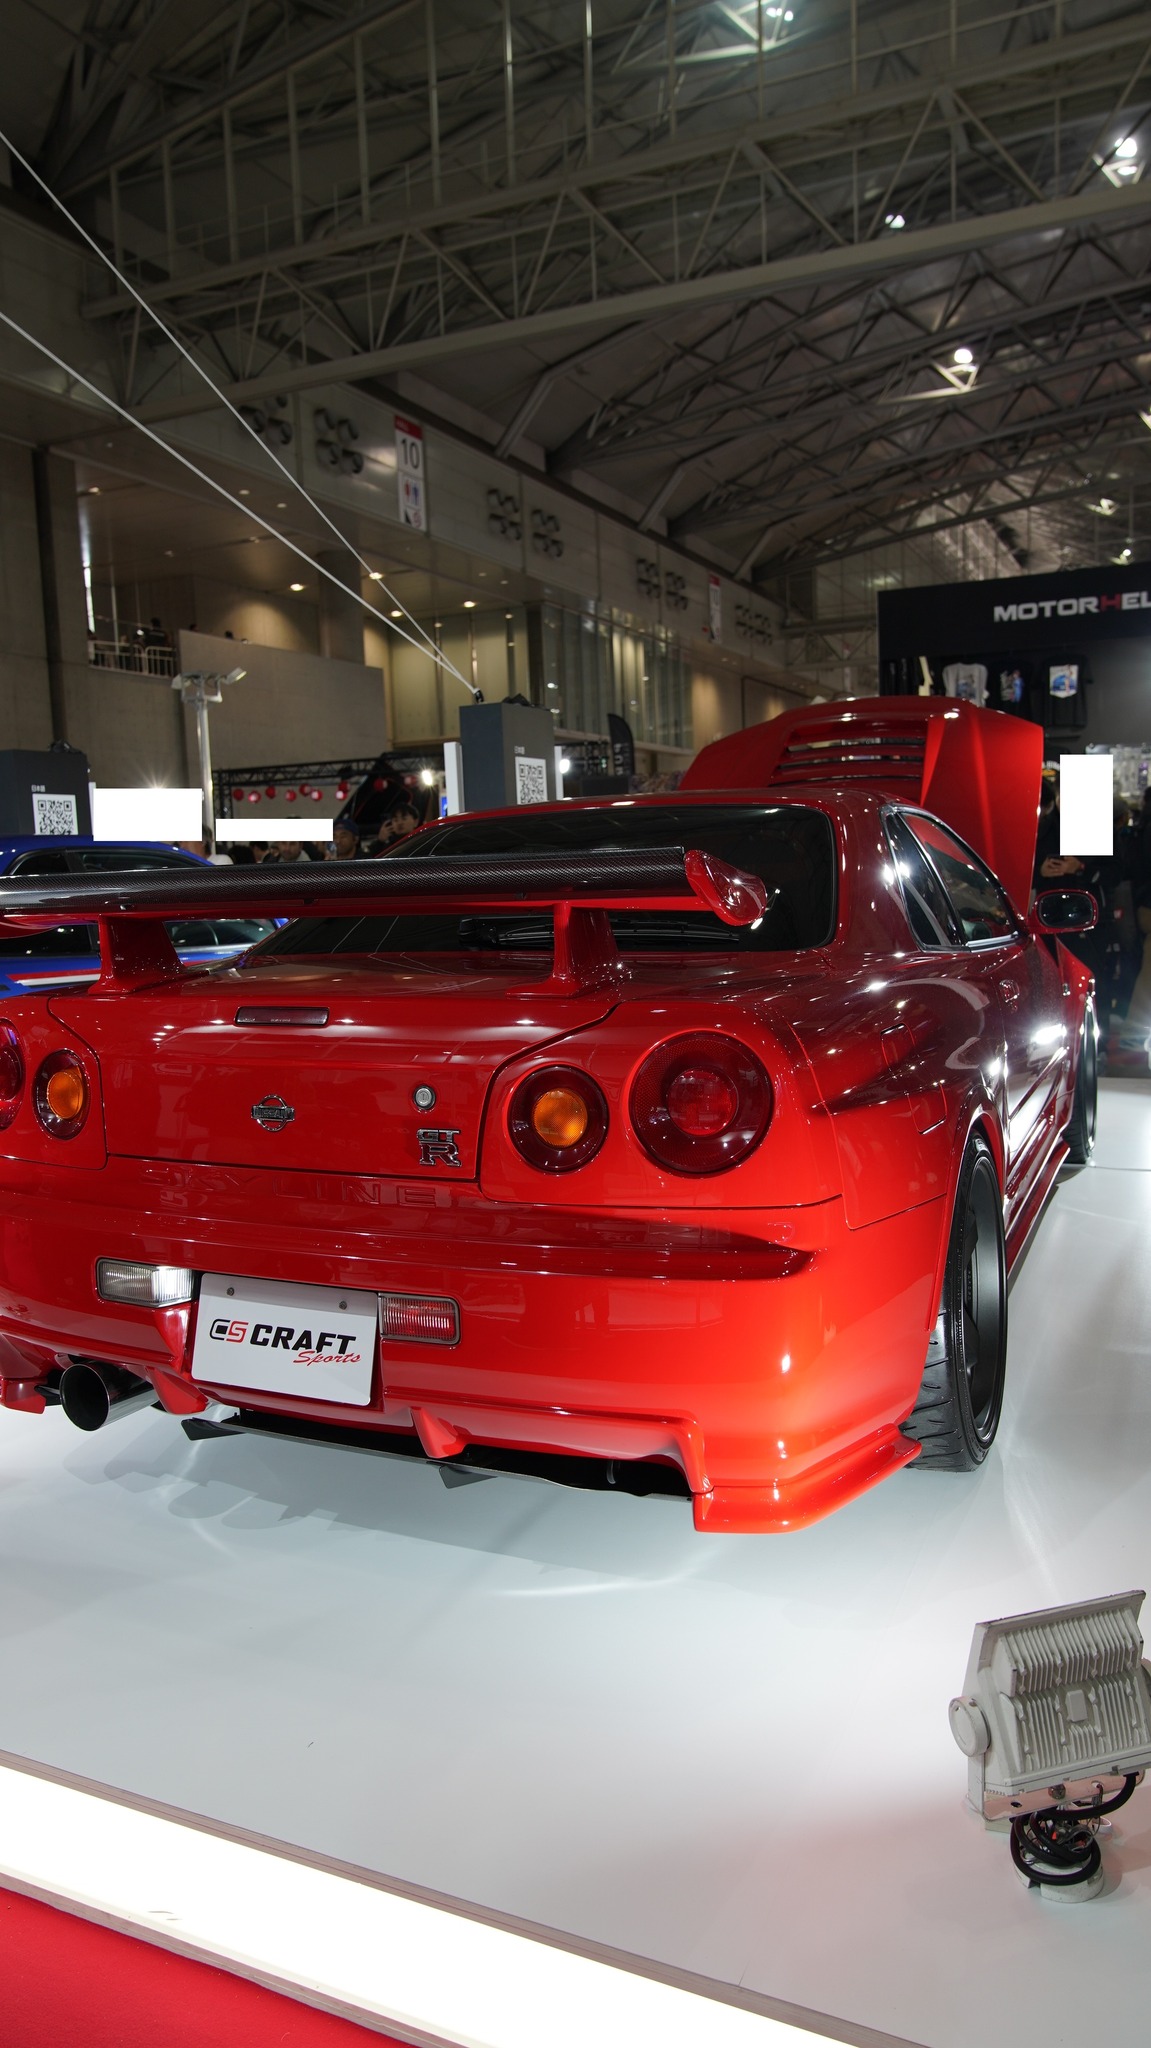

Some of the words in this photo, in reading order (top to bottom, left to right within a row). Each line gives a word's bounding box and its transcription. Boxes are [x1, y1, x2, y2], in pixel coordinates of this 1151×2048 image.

[401, 439, 420, 469] 10
[249, 1323, 356, 1355] CRAFT
[293, 1350, 361, 1367] Sports
